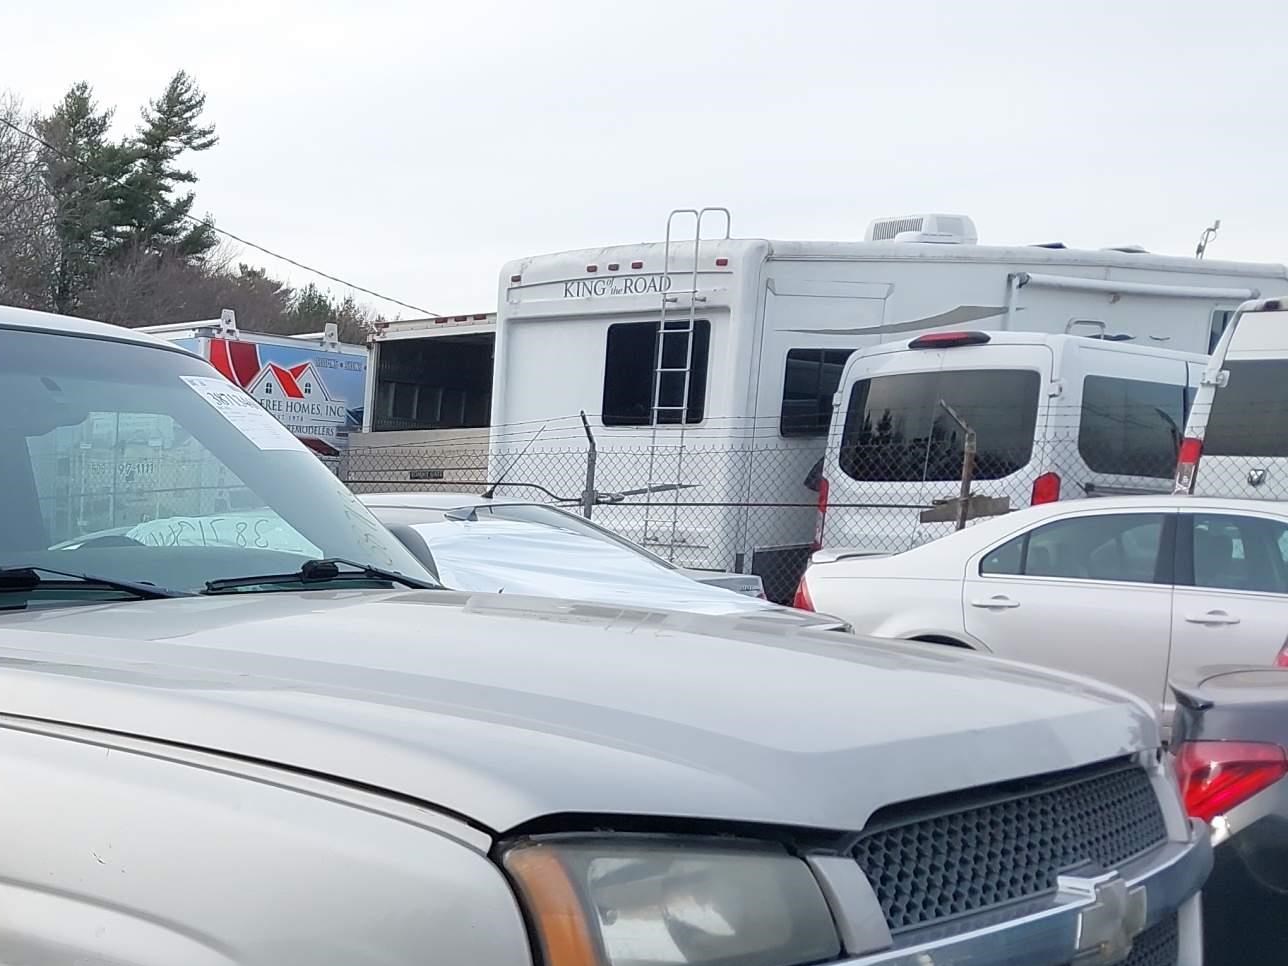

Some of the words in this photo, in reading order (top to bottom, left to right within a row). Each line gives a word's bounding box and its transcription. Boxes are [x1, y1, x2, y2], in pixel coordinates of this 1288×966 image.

[564, 279, 606, 298] KING
[606, 278, 615, 288] of
[610, 285, 623, 295] the
[623, 275, 672, 294] ROAD
[285, 401, 323, 417] HOMES,
